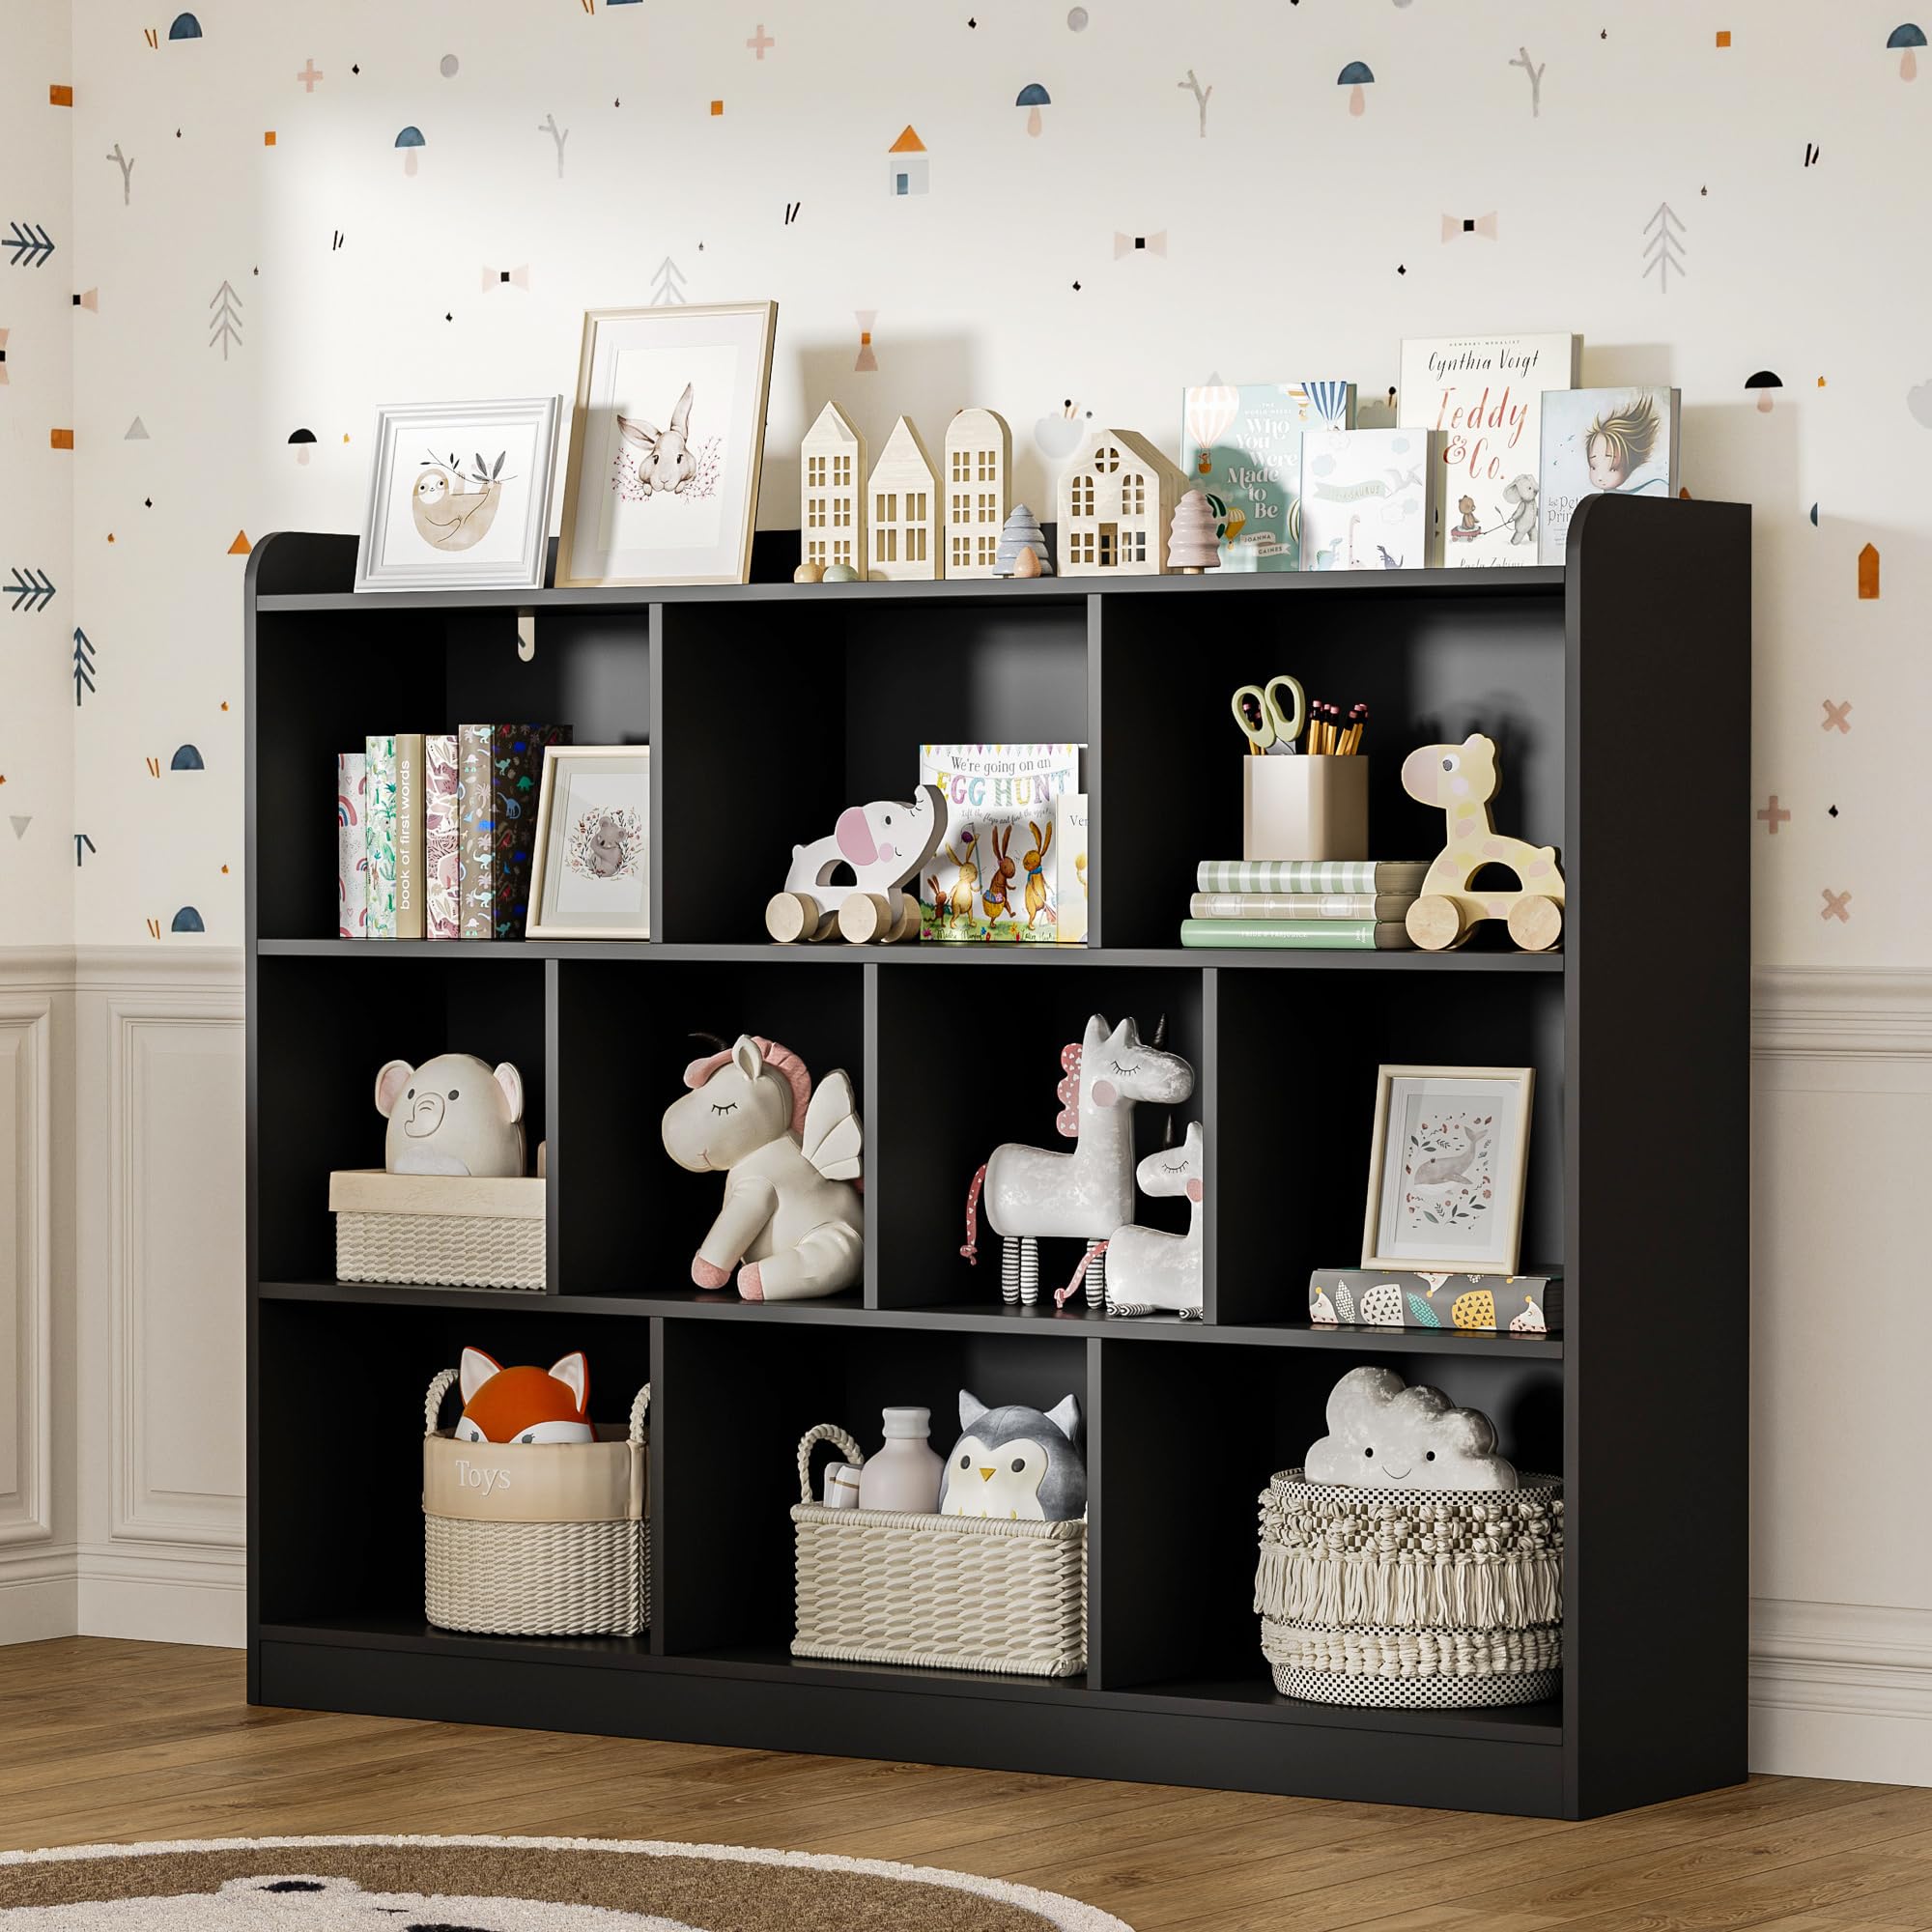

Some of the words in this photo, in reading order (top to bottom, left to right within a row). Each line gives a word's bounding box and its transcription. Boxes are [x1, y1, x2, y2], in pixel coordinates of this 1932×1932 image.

[1429, 350, 1492, 382] Cynthia
[1499, 348, 1539, 379] Voigt
[1246, 417, 1291, 440] Who
[1437, 385, 1528, 449] Teddy
[1236, 433, 1270, 449] You
[1249, 450, 1298, 467] Were
[1442, 435, 1467, 465] &
[1469, 438, 1505, 480] Co.
[1228, 468, 1280, 490] Made
[1248, 484, 1267, 501] to
[1255, 502, 1279, 519] Be
[1244, 533, 1272, 543] JOANNA
[951, 755, 980, 772] We're
[983, 760, 1015, 777] going
[1019, 760, 1034, 773] on
[1037, 758, 1051, 769] an
[400, 760, 411, 810] words
[937, 771, 986, 807] EGG
[993, 769, 1070, 807] HUNT
[399, 813, 411, 844] first
[400, 849, 411, 866] of
[400, 869, 411, 910] book
[455, 1460, 511, 1497] Toys
